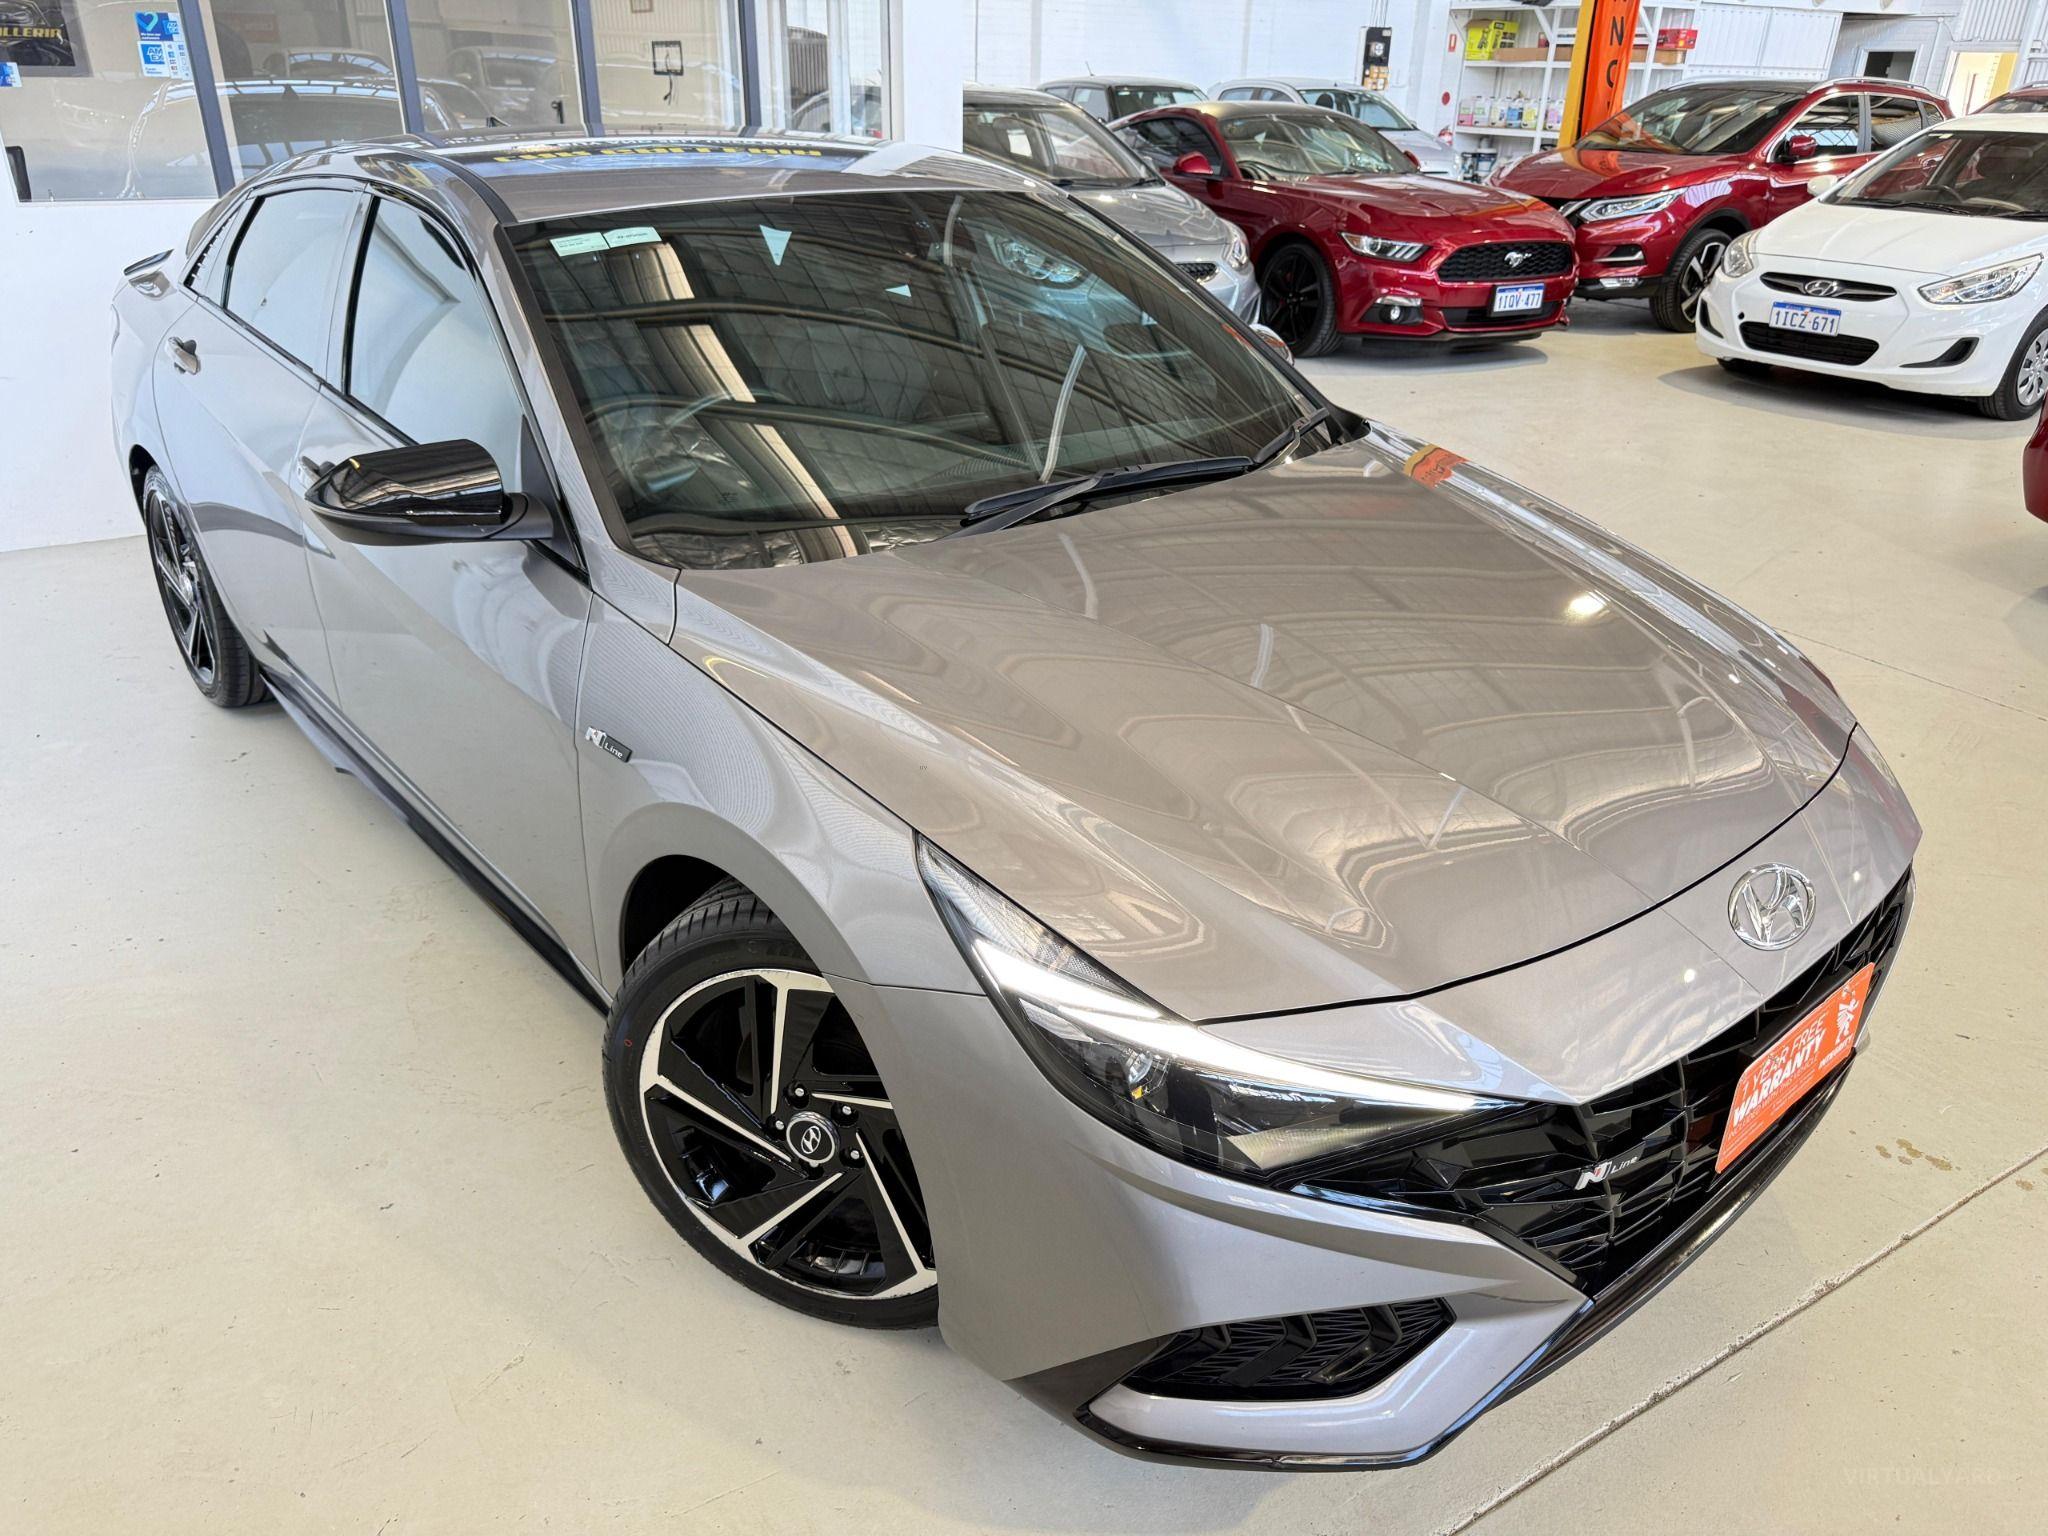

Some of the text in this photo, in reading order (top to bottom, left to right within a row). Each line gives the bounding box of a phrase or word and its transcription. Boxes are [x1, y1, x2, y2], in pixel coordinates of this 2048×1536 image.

[604, 742, 623, 758] Line
[1750, 1043, 1789, 1092] YEAR
[1790, 1011, 1825, 1056] FREE
[1731, 1027, 1826, 1128] WARRANTY
[1610, 1156, 1638, 1174] Line
